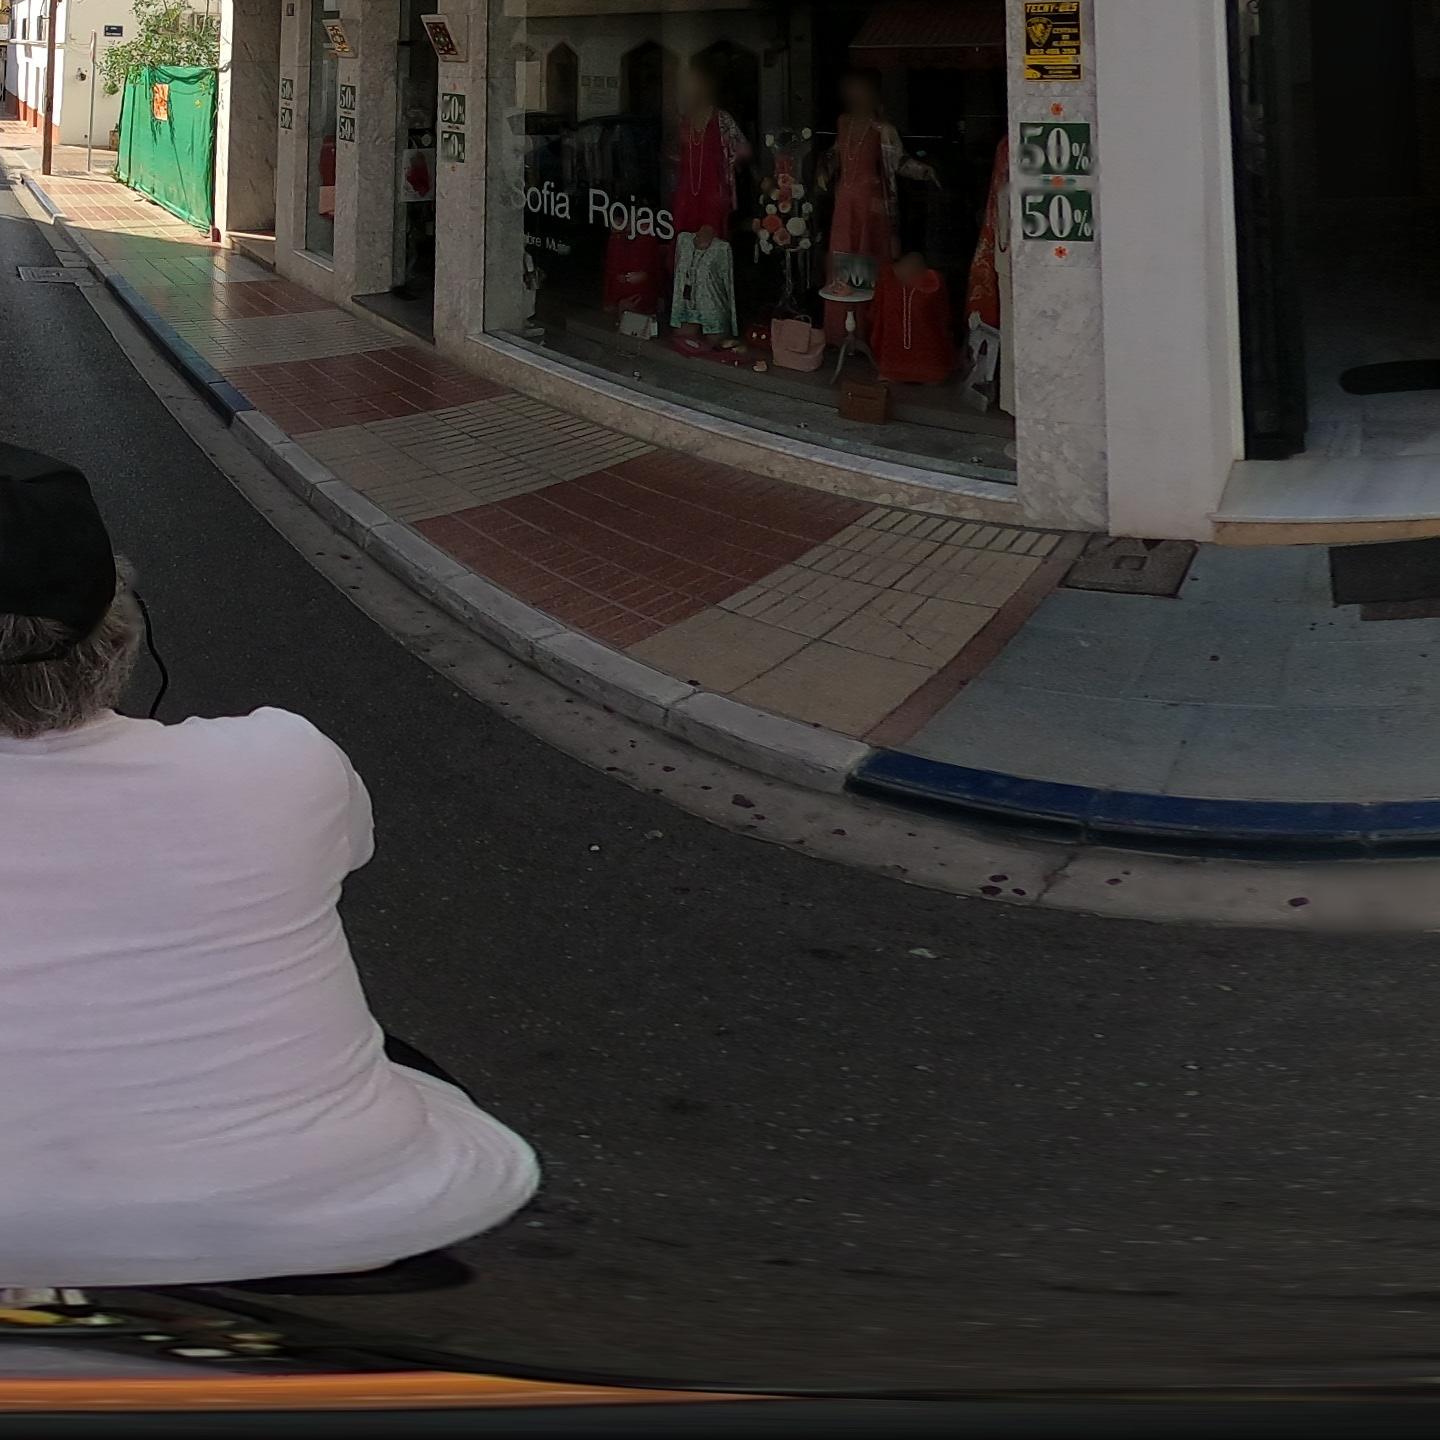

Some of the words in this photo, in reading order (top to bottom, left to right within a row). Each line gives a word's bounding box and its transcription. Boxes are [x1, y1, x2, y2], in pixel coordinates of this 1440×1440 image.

[1020, 126, 1089, 173] 50%
[511, 180, 570, 220] Sofia
[588, 188, 675, 240] Rojas
[1023, 194, 1092, 238] 50%
